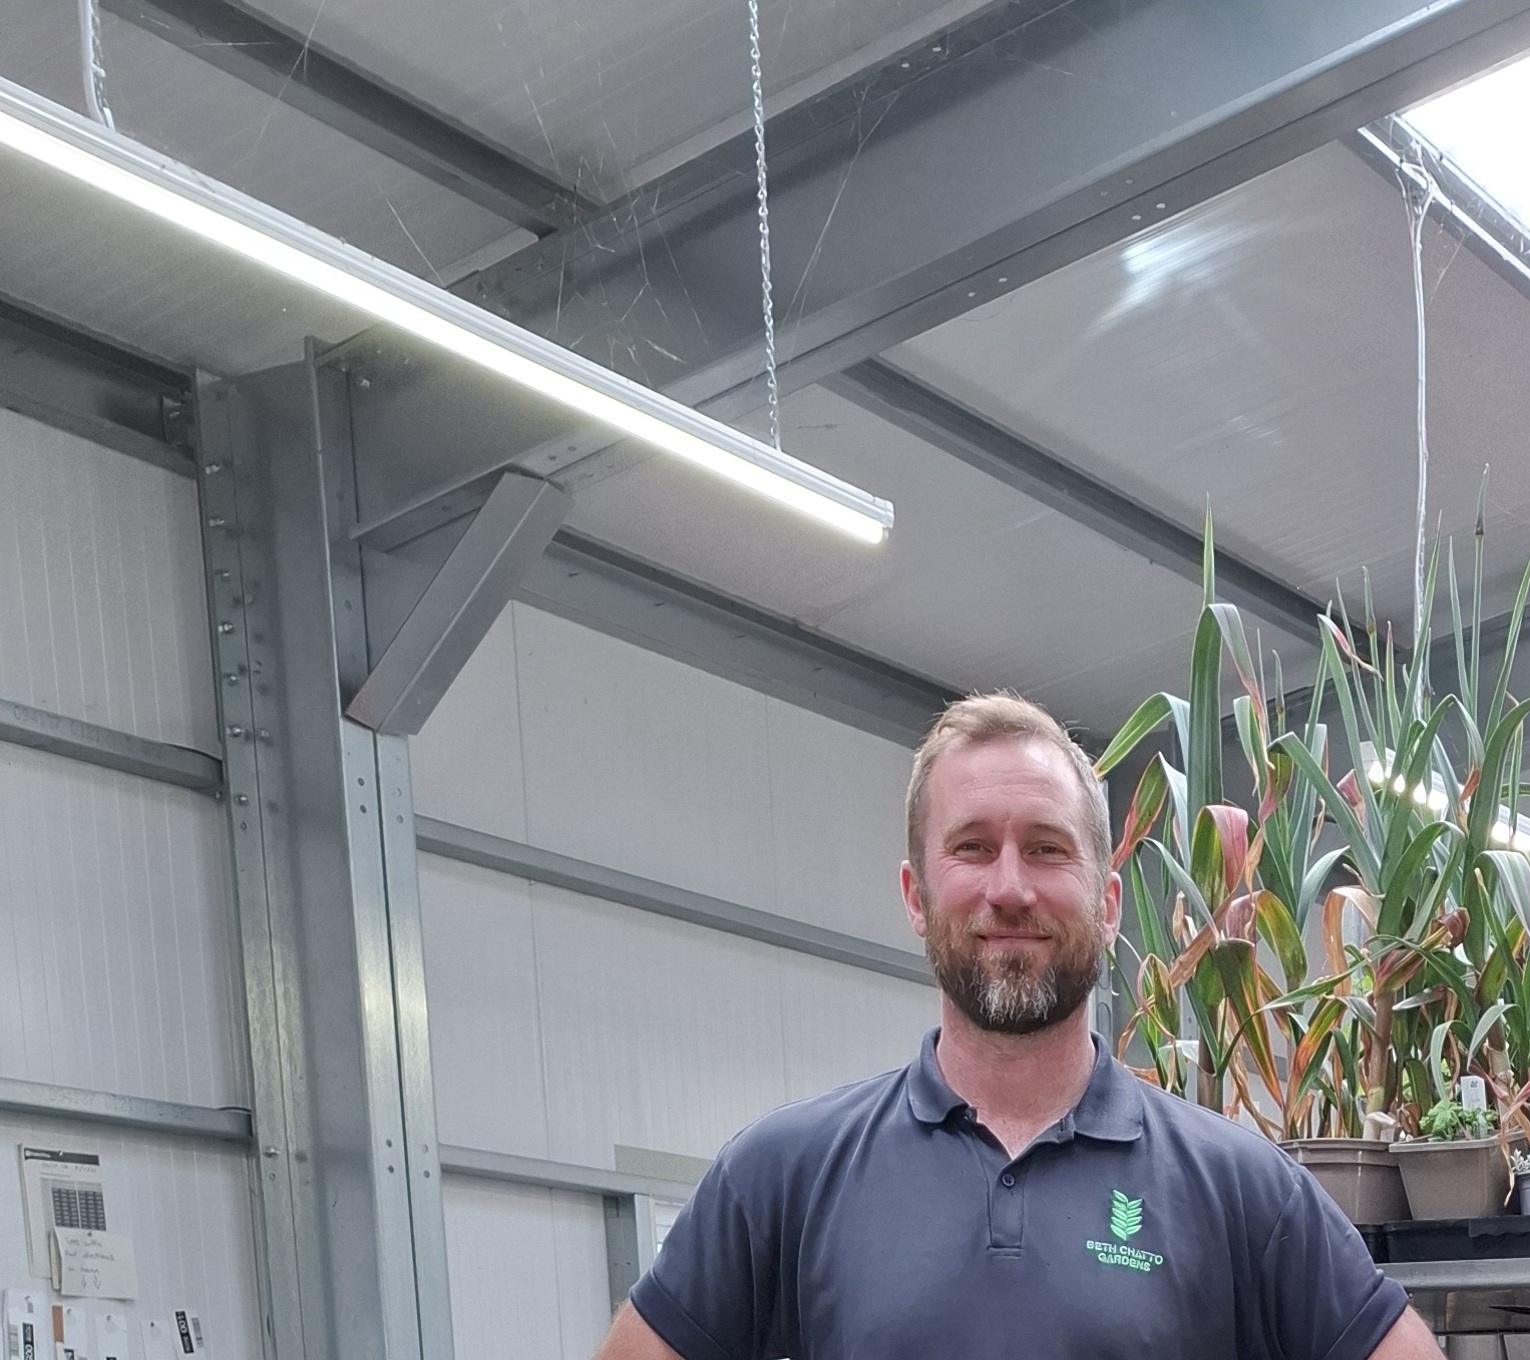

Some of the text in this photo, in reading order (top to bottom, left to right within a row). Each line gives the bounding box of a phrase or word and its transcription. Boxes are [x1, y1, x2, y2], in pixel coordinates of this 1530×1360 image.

[1086, 1240, 1164, 1265] BETH CHATTO
[1098, 1252, 1150, 1271] GARDENS
